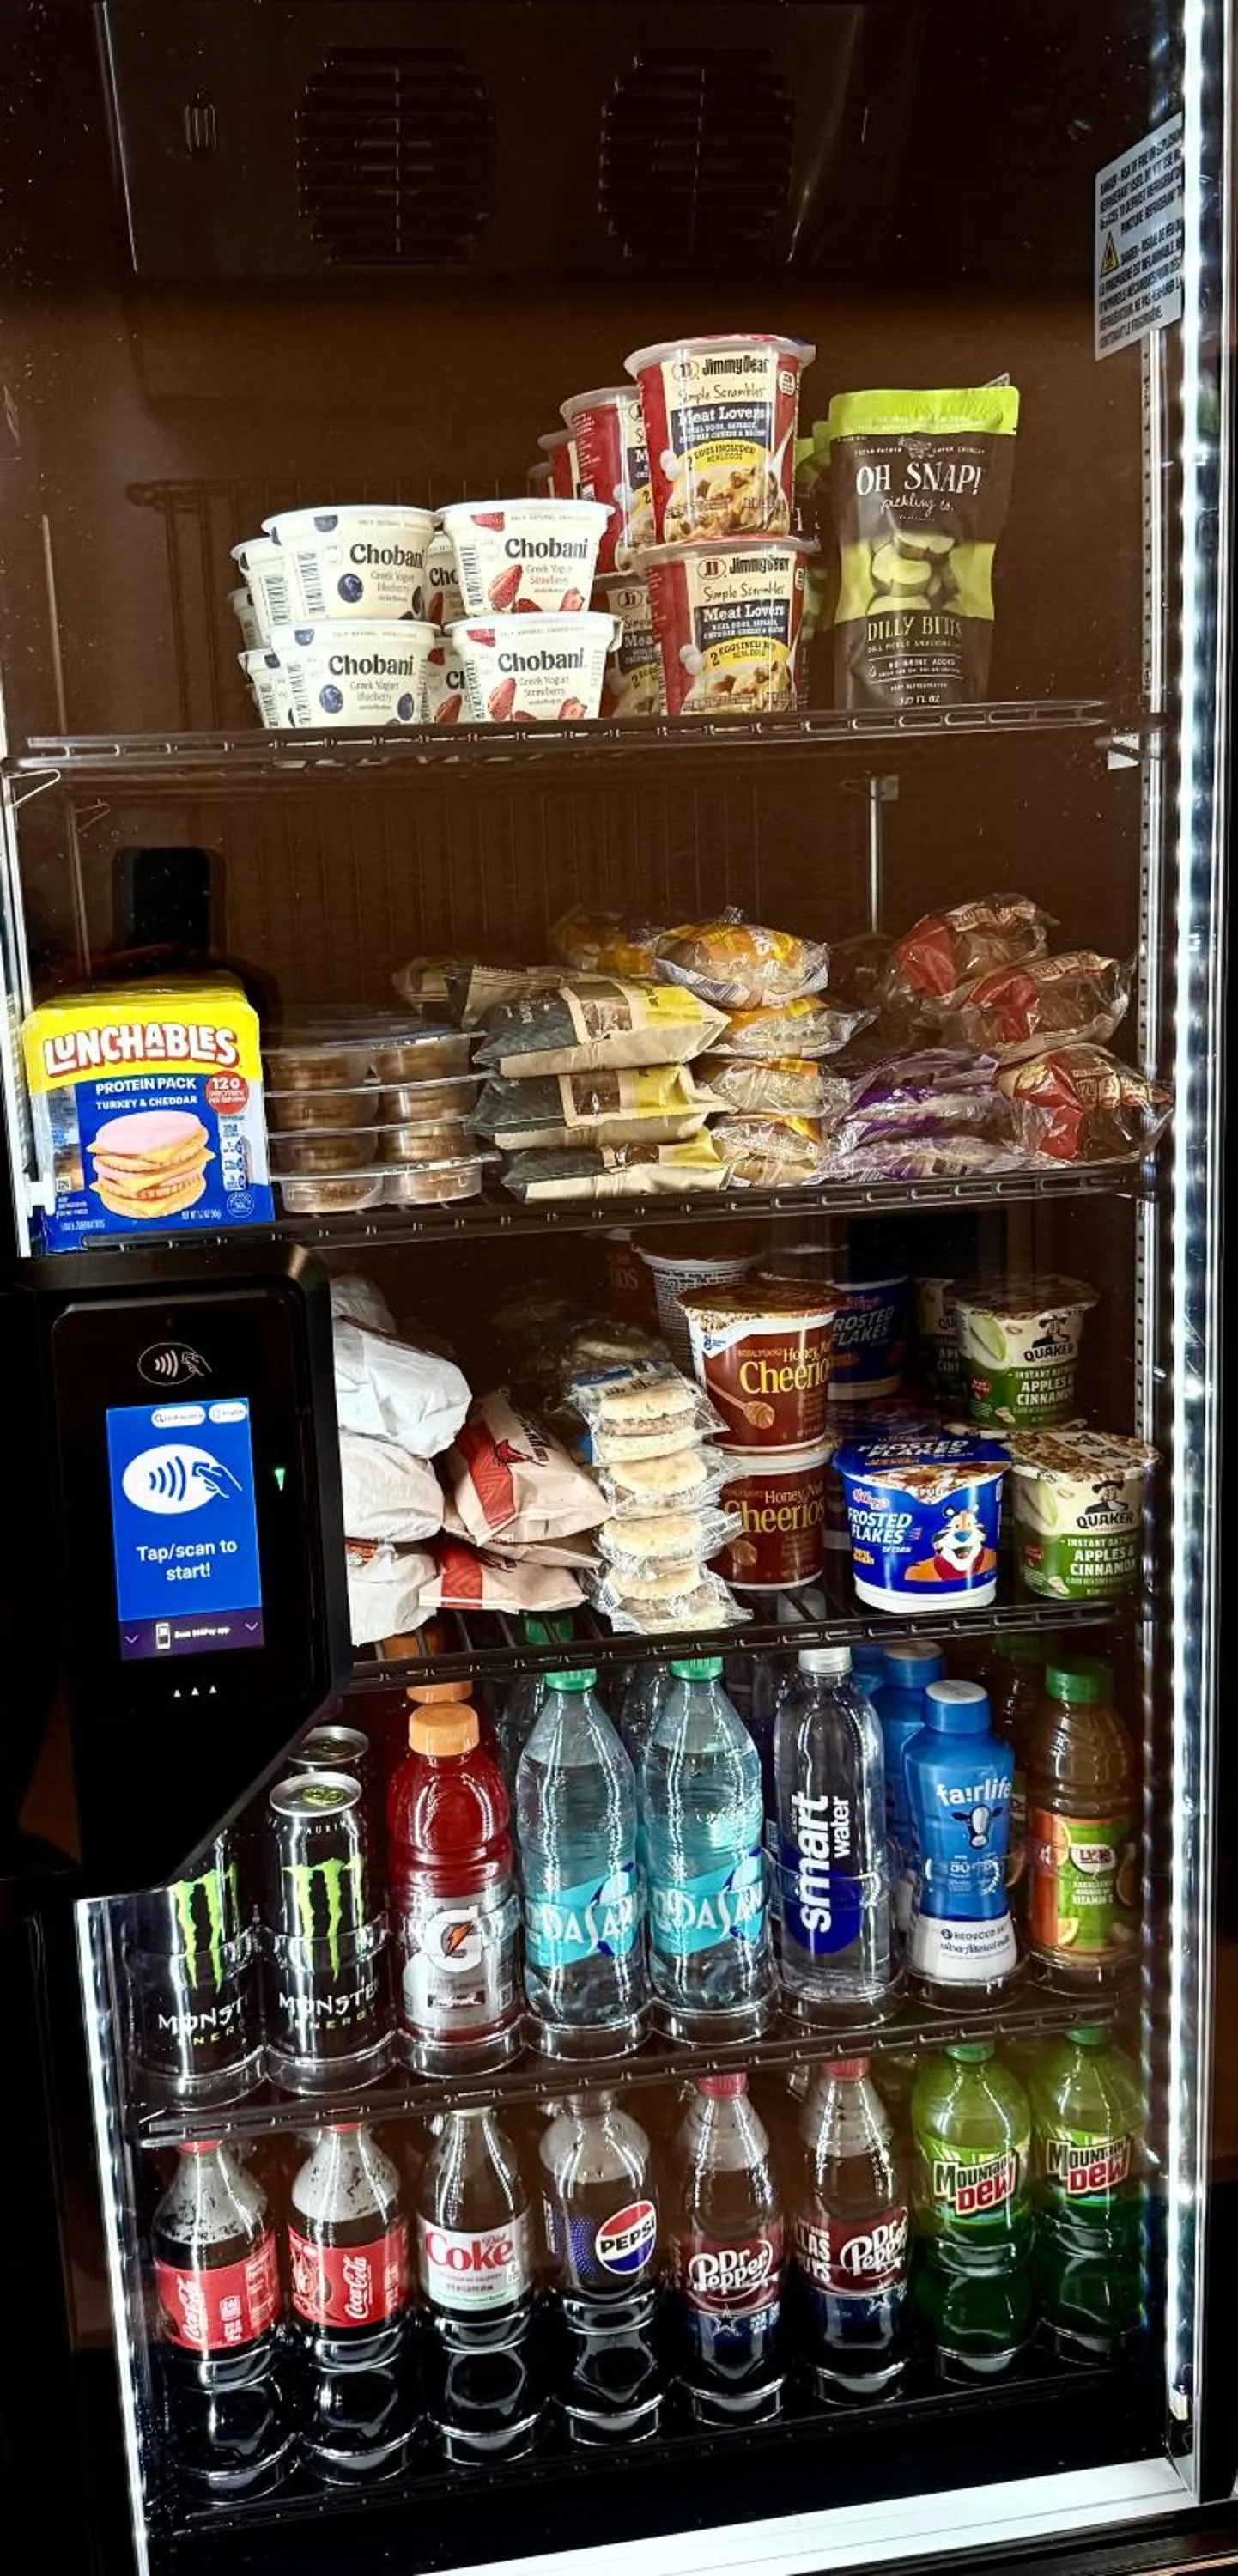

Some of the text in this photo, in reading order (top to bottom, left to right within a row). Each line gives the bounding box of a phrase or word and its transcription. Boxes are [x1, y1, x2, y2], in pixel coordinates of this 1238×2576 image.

[702, 356, 743, 376] Jimmy
[678, 383, 766, 406] Simple Scrambles
[679, 405, 765, 425] Meat Lovers
[856, 461, 982, 495] OH SNAP!
[880, 492, 936, 518] pickling
[349, 543, 425, 568] Chobani
[504, 538, 588, 559] Chobani
[730, 556, 766, 574] Jimmy
[703, 586, 737, 602] Simple
[702, 603, 785, 623] Meat Lovers
[868, 616, 916, 641] DILLY
[624, 635, 653, 649] Mea
[328, 654, 414, 676] Chobani
[497, 648, 585, 672] Chobani
[710, 651, 720, 667] 2
[44, 1022, 241, 1078] LUNCHABLES
[95, 1078, 197, 1095] PROTEIN PACK
[96, 1100, 137, 1111] TURKEY
[149, 1096, 197, 1109] CHEDDAR
[834, 1305, 895, 1332] ROSTED
[1024, 1344, 1073, 1362] QUAKER
[740, 1360, 830, 1394] Cheerio
[1021, 1376, 1067, 1393] APPLES
[1016, 1388, 1073, 1406] CINNAMO
[857, 1440, 969, 1453] FROSTED
[866, 1447, 962, 1458] FLAKES
[765, 1490, 807, 1505] Honey
[848, 1507, 913, 1529] FROSTED
[1077, 1511, 1135, 1529] QUAKER
[851, 1523, 905, 1545] FLAKES
[1067, 1538, 1106, 1548] INSTANT
[137, 1540, 237, 1564] Tap/scan to
[1074, 1546, 1126, 1562] APPLES
[166, 1562, 211, 1581] start!
[830, 1795, 851, 1859] water
[797, 1795, 832, 1933] smart
[1072, 1894, 1107, 1905] VITAMIN
[677, 1886, 761, 1938] DASAN
[542, 1895, 634, 1953] DASAN
[426, 1905, 482, 1972] G
[601, 2215, 655, 2254] PEPSI
[871, 2218, 898, 2246] Dr
[426, 2232, 513, 2271] Coke
[718, 2248, 751, 2274] Dr
[688, 2249, 768, 2296] Pepper
[343, 2254, 370, 2319] Coca-Cola
